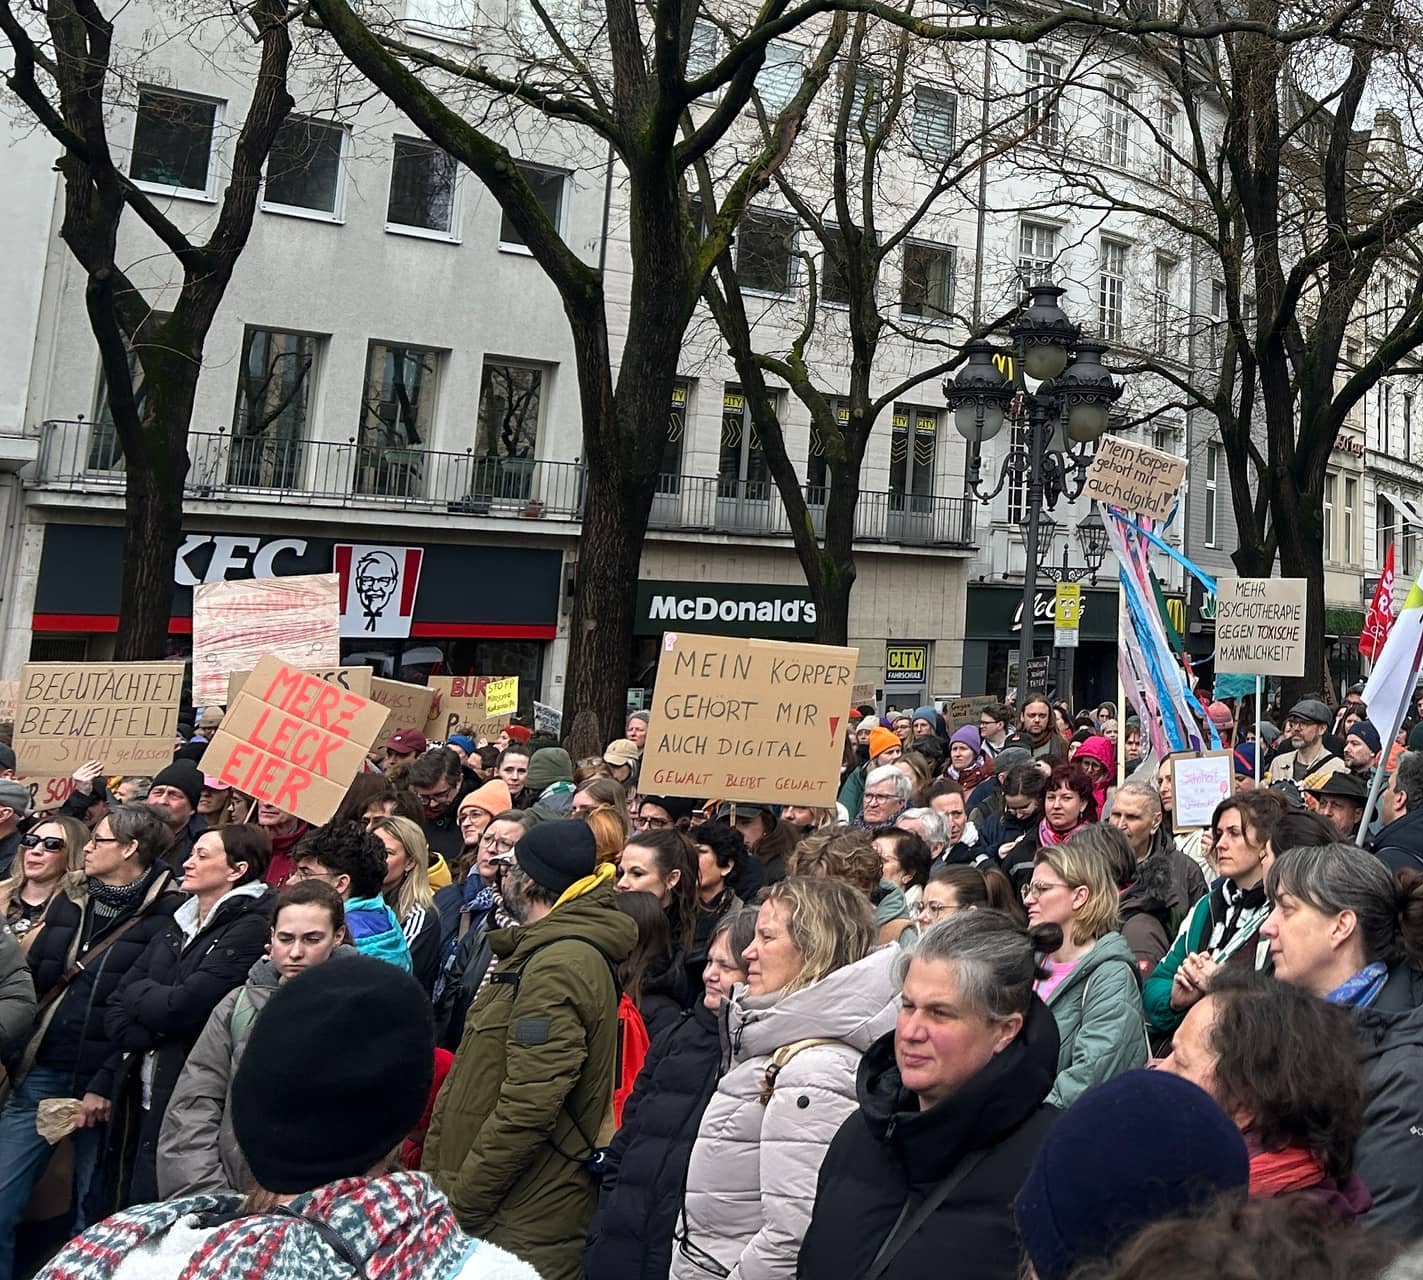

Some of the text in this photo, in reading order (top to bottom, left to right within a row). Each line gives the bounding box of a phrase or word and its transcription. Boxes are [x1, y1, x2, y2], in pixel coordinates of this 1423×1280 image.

[1101, 438, 1135, 460] Mein
[1134, 469, 1157, 486] mir
[174, 535, 307, 585] KFC
[1235, 581, 1266, 598] MEHR
[649, 596, 817, 623] McDonald's
[1218, 601, 1300, 621] PSYCHOTHERAPIE
[1218, 624, 1300, 641] GEGEN TOXISCHE
[674, 651, 850, 685] MEIN KÖRPER
[889, 651, 922, 668] CITY
[450, 677, 489, 697] BUR
[263, 666, 368, 738] MERZ
[664, 694, 758, 724] GEHÖRT
[776, 702, 818, 726] MIR
[112, 741, 171, 764] gelassen
[247, 706, 345, 778] LECK
[658, 733, 807, 757] AUCH DIGITAL
[218, 742, 313, 813] EIER
[654, 769, 828, 791] GEWALT BLEIBT GEWALT
